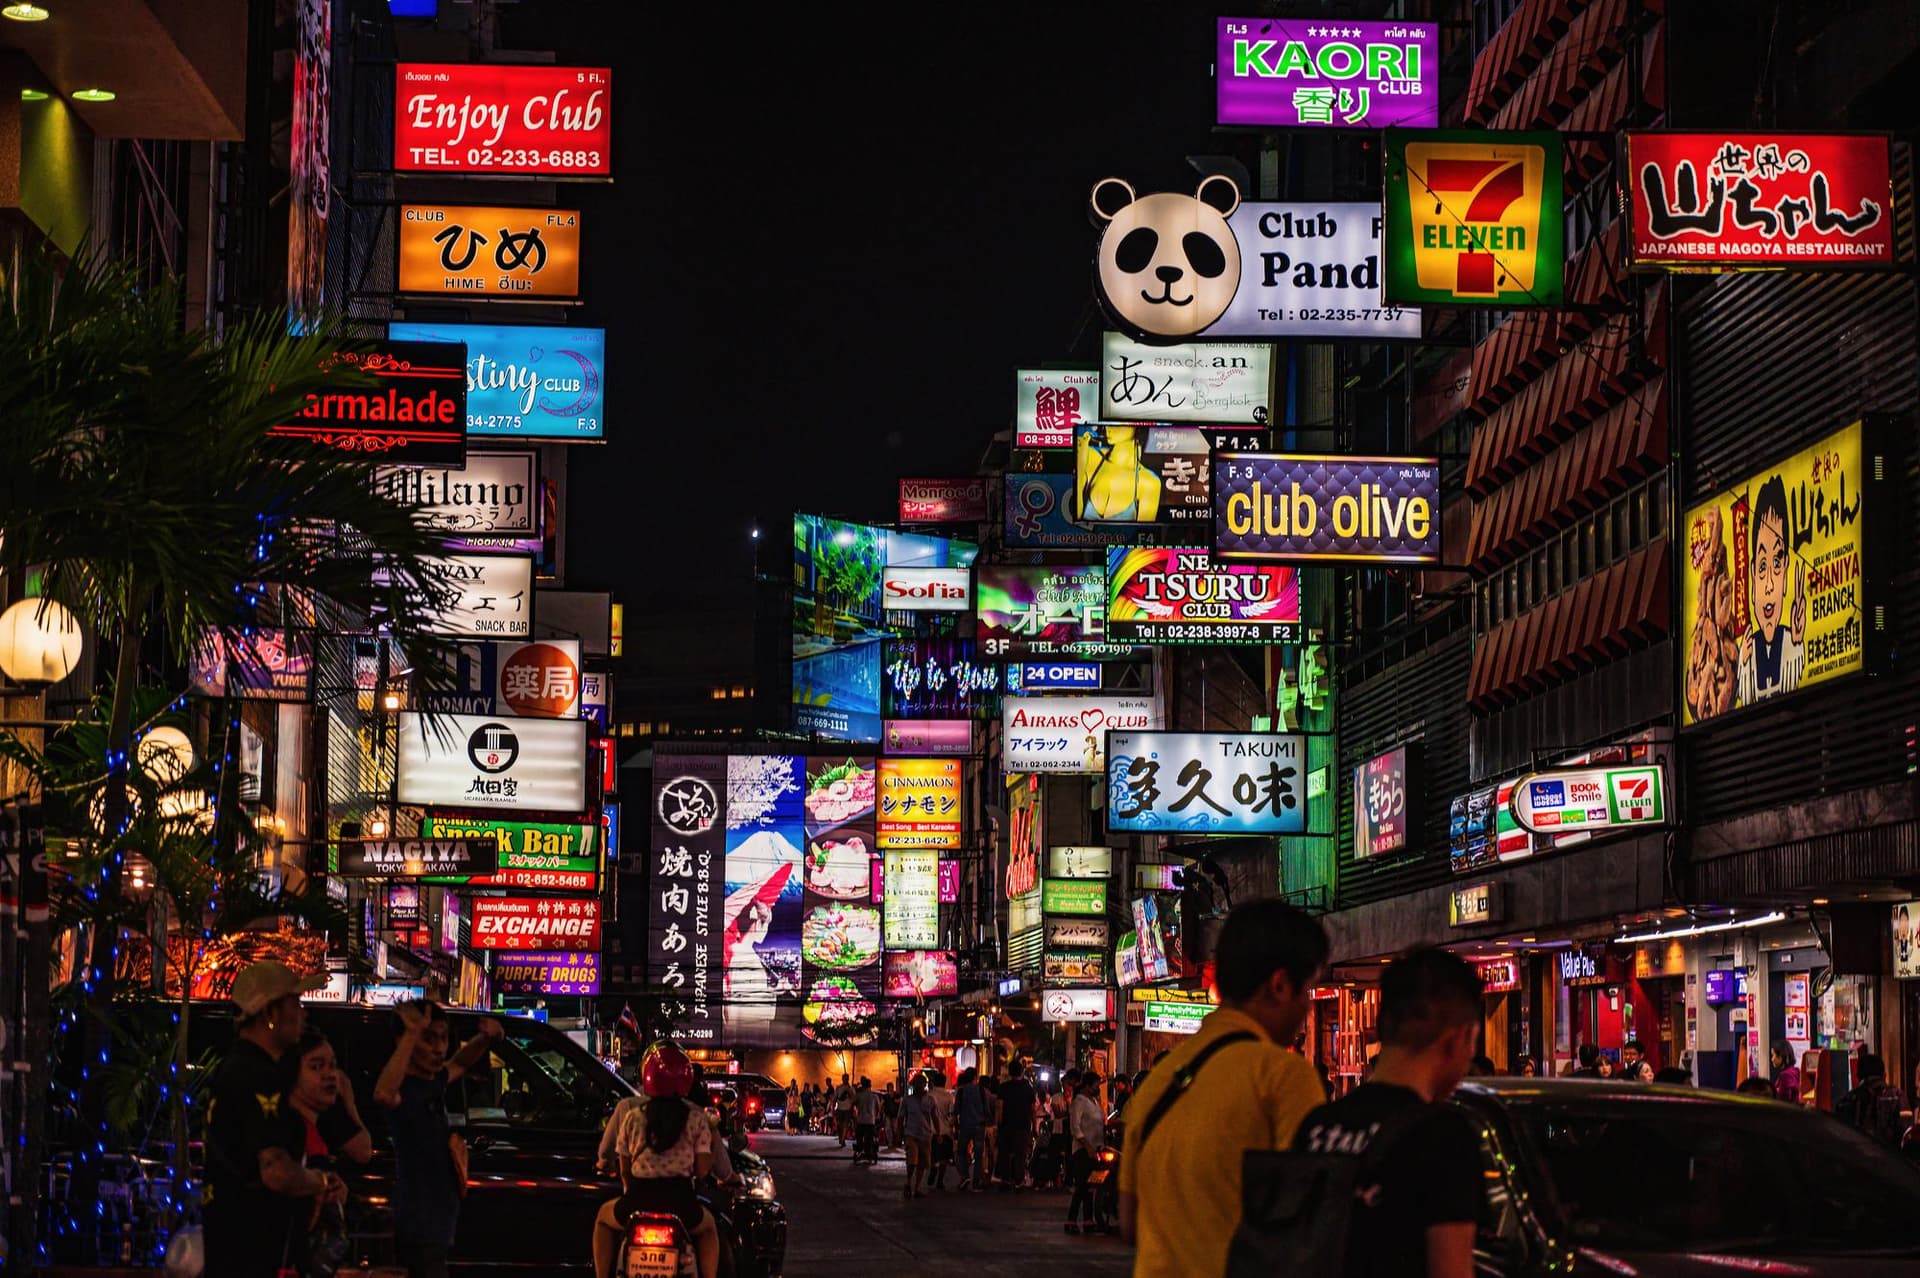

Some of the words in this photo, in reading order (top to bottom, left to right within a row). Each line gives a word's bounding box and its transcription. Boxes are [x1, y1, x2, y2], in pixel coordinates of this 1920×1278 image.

[1233, 39, 1422, 81] KAORI
[577, 72, 584, 83] 5
[1378, 80, 1422, 95] CLUB
[1293, 87, 1370, 124] 香り
[408, 93, 510, 146] Enjoy
[523, 90, 603, 131] Club
[409, 147, 460, 166] TEL.
[467, 148, 600, 168] 02-233-6883
[1715, 144, 1809, 179] 世界の
[1642, 161, 1880, 239] 山ちゃん
[405, 210, 445, 223] CLUB
[1258, 212, 1337, 239] Club
[434, 225, 548, 275] ひめ
[1639, 243, 1716, 255] JAPANESE
[1720, 243, 1783, 255] NAGOYA
[1786, 244, 1884, 256] RESTAURANT
[445, 277, 485, 290] HIME
[1258, 308, 1284, 321] Tel
[1299, 308, 1403, 322] 02-235-7737
[544, 378, 581, 392] CLUB
[1064, 376, 1084, 384] Club
[1110, 355, 1186, 408] あん
[294, 388, 456, 423] armalade
[577, 418, 597, 430] F.3
[1185, 495, 1208, 504] Club
[1226, 481, 1317, 538] club
[1332, 483, 1430, 540] olive
[1807, 552, 1860, 597] THANIYA
[885, 580, 965, 599] Sofia
[1140, 574, 1270, 601] TSURU
[1182, 602, 1232, 618] CLUB
[1812, 583, 1854, 622] BRANCH
[476, 620, 505, 633] SNACK
[510, 621, 528, 633] BAR
[1136, 626, 1156, 637] Tel
[1168, 626, 1260, 638] 02-238-3997-8
[1272, 627, 1290, 638] F2
[985, 639, 1010, 655] 3F
[1028, 641, 1059, 654] TEL.
[1061, 642, 1082, 654] 062
[1085, 643, 1106, 656] 590
[1108, 644, 1132, 656] 1919
[272, 674, 308, 687] YUME
[1026, 666, 1045, 680] 24
[1048, 667, 1096, 681] OPEN
[504, 664, 575, 700] 薬局
[1106, 714, 1148, 728] CLUB
[1010, 736, 1068, 751] アイラック
[1219, 742, 1296, 758] TAKUMI
[1010, 760, 1024, 768] Tel
[1030, 760, 1081, 768] 02-062-2344
[884, 778, 954, 788] CINNAMON
[1118, 756, 1297, 818] 多久味
[1570, 782, 1600, 794] BOOK
[882, 795, 956, 814] シナモン
[896, 824, 912, 832] Song
[523, 829, 574, 855] Bar
[363, 842, 470, 862] NAGIYA
[376, 863, 408, 873] TOKYO
[516, 874, 587, 887] 02-652-5465
[694, 895, 709, 937] STYLE
[477, 916, 594, 936] EXCHANGE
[496, 966, 548, 981] PURPLE
[551, 966, 597, 982] DRUGS
[1164, 1004, 1202, 1016] FamilyMart
